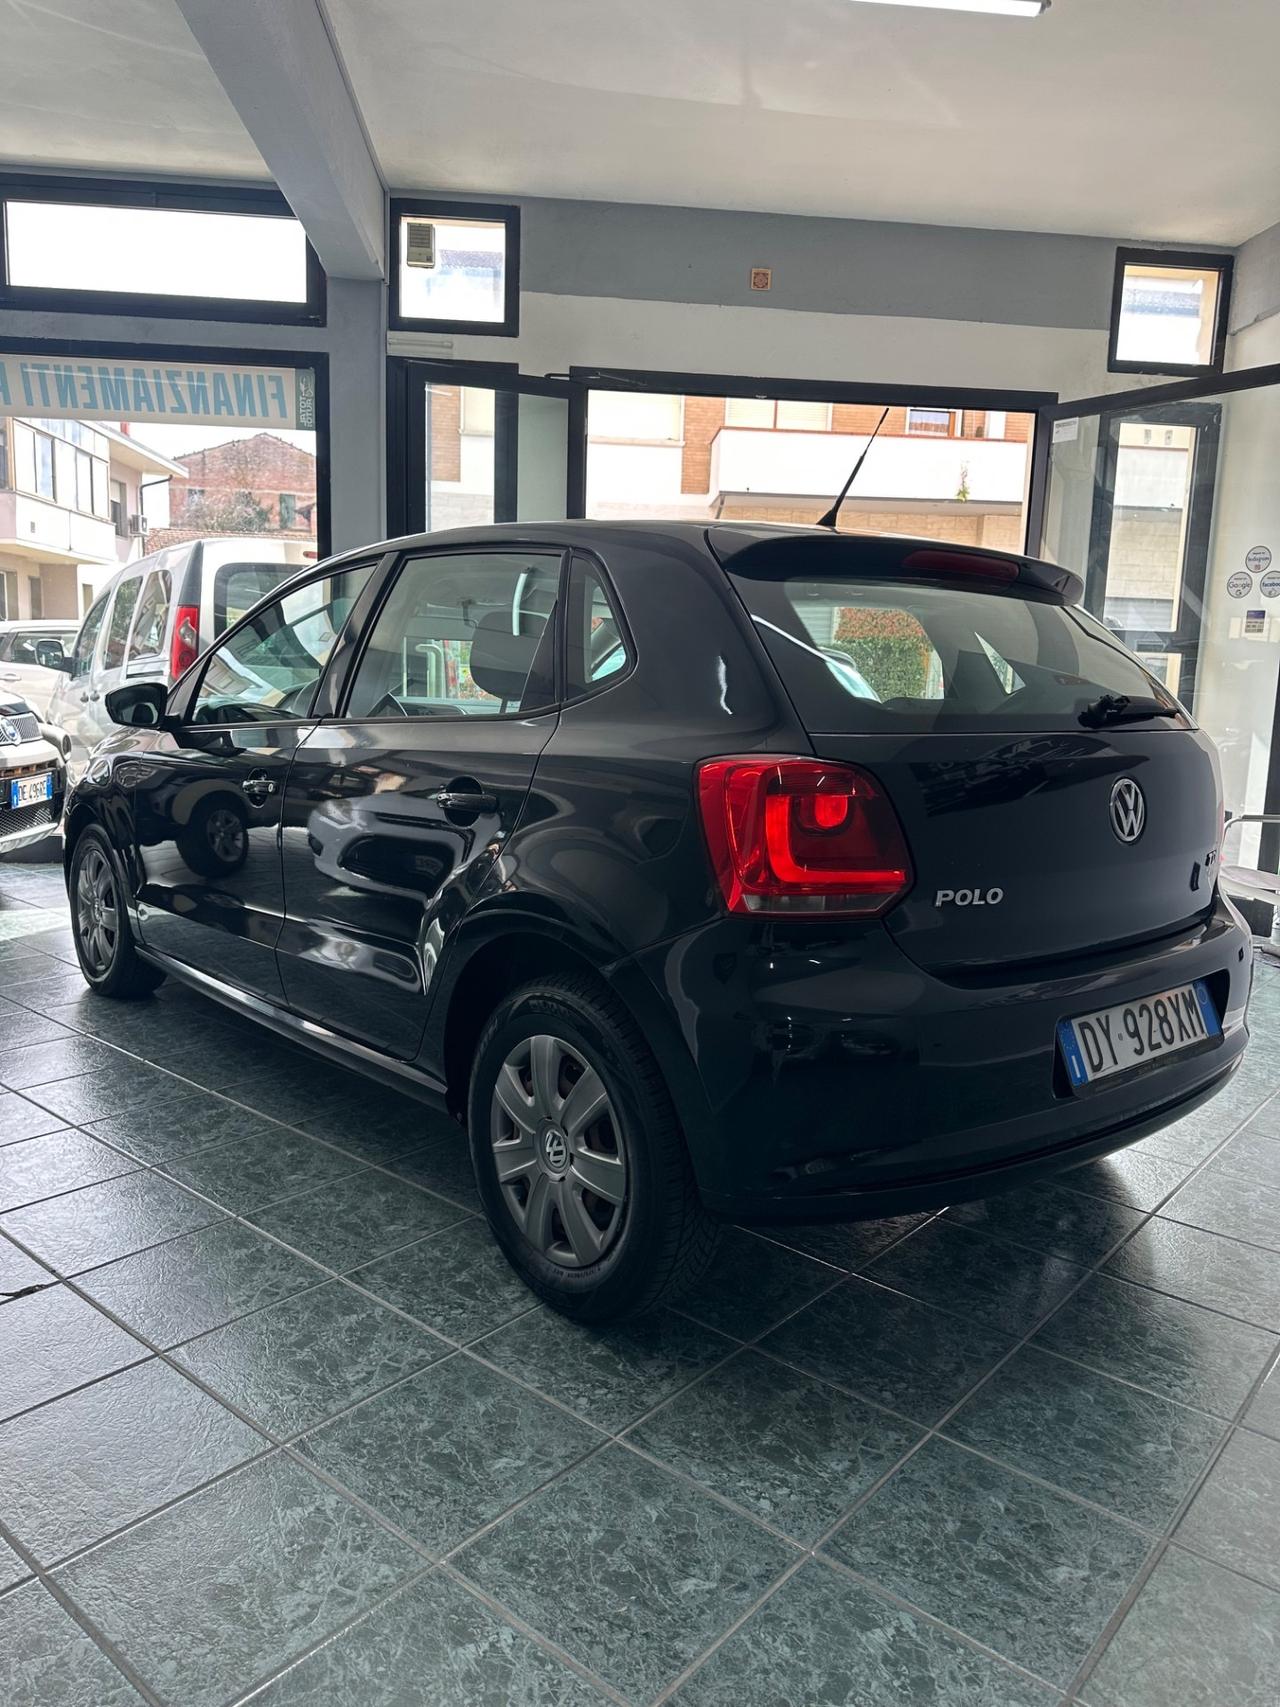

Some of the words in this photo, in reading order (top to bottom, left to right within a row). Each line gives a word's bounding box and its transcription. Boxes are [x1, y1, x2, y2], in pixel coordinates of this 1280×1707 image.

[1228, 581, 1250, 590] Google
[935, 887, 1004, 907] POLO
[1078, 1014, 1119, 1073] DY
[1123, 989, 1206, 1056] 928XM
